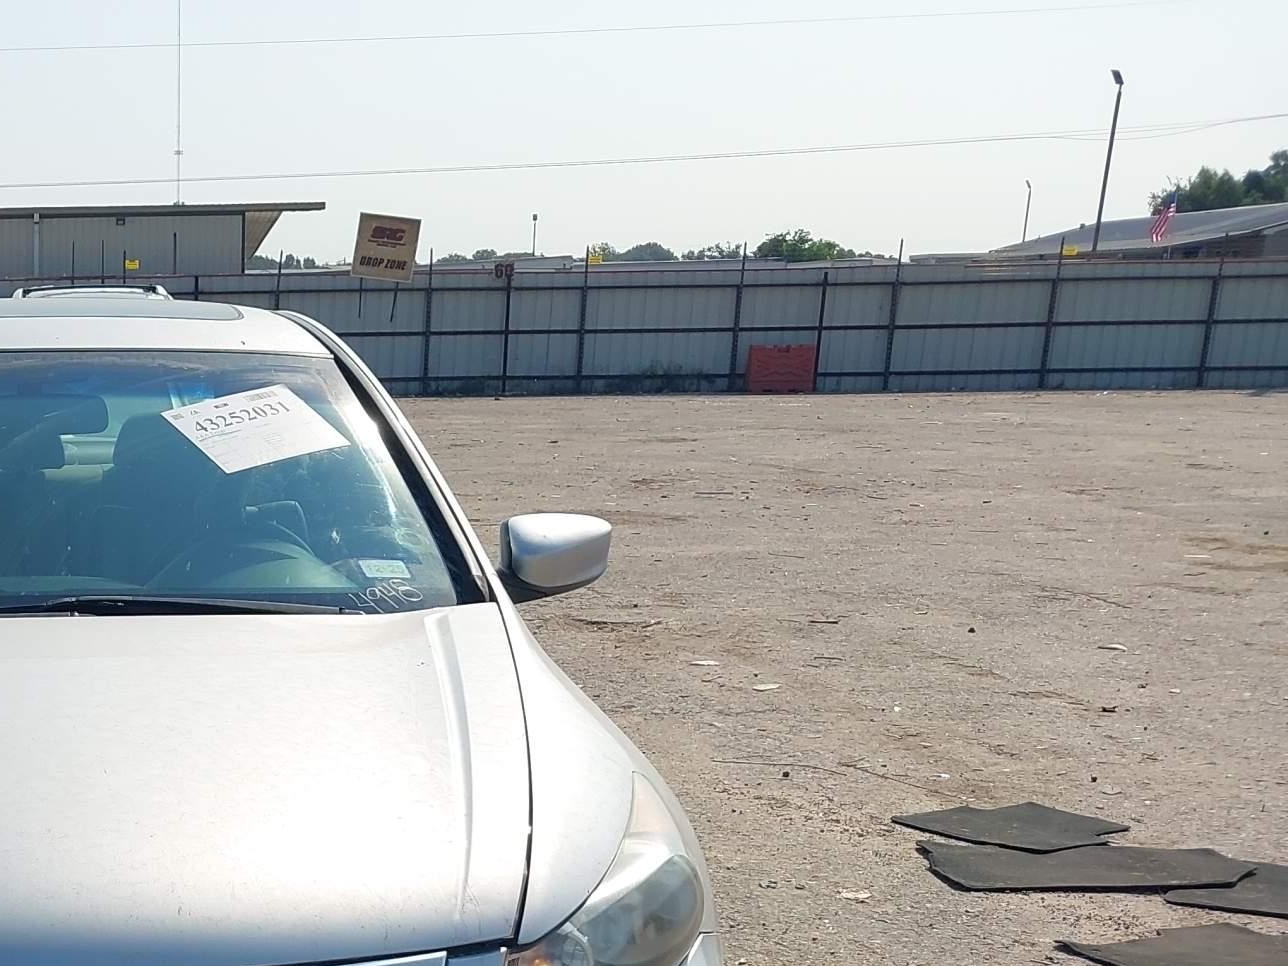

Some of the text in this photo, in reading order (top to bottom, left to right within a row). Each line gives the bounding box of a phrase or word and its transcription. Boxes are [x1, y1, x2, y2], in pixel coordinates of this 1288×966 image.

[359, 256, 408, 270] DROP ZONE
[195, 401, 291, 433] 43252031
